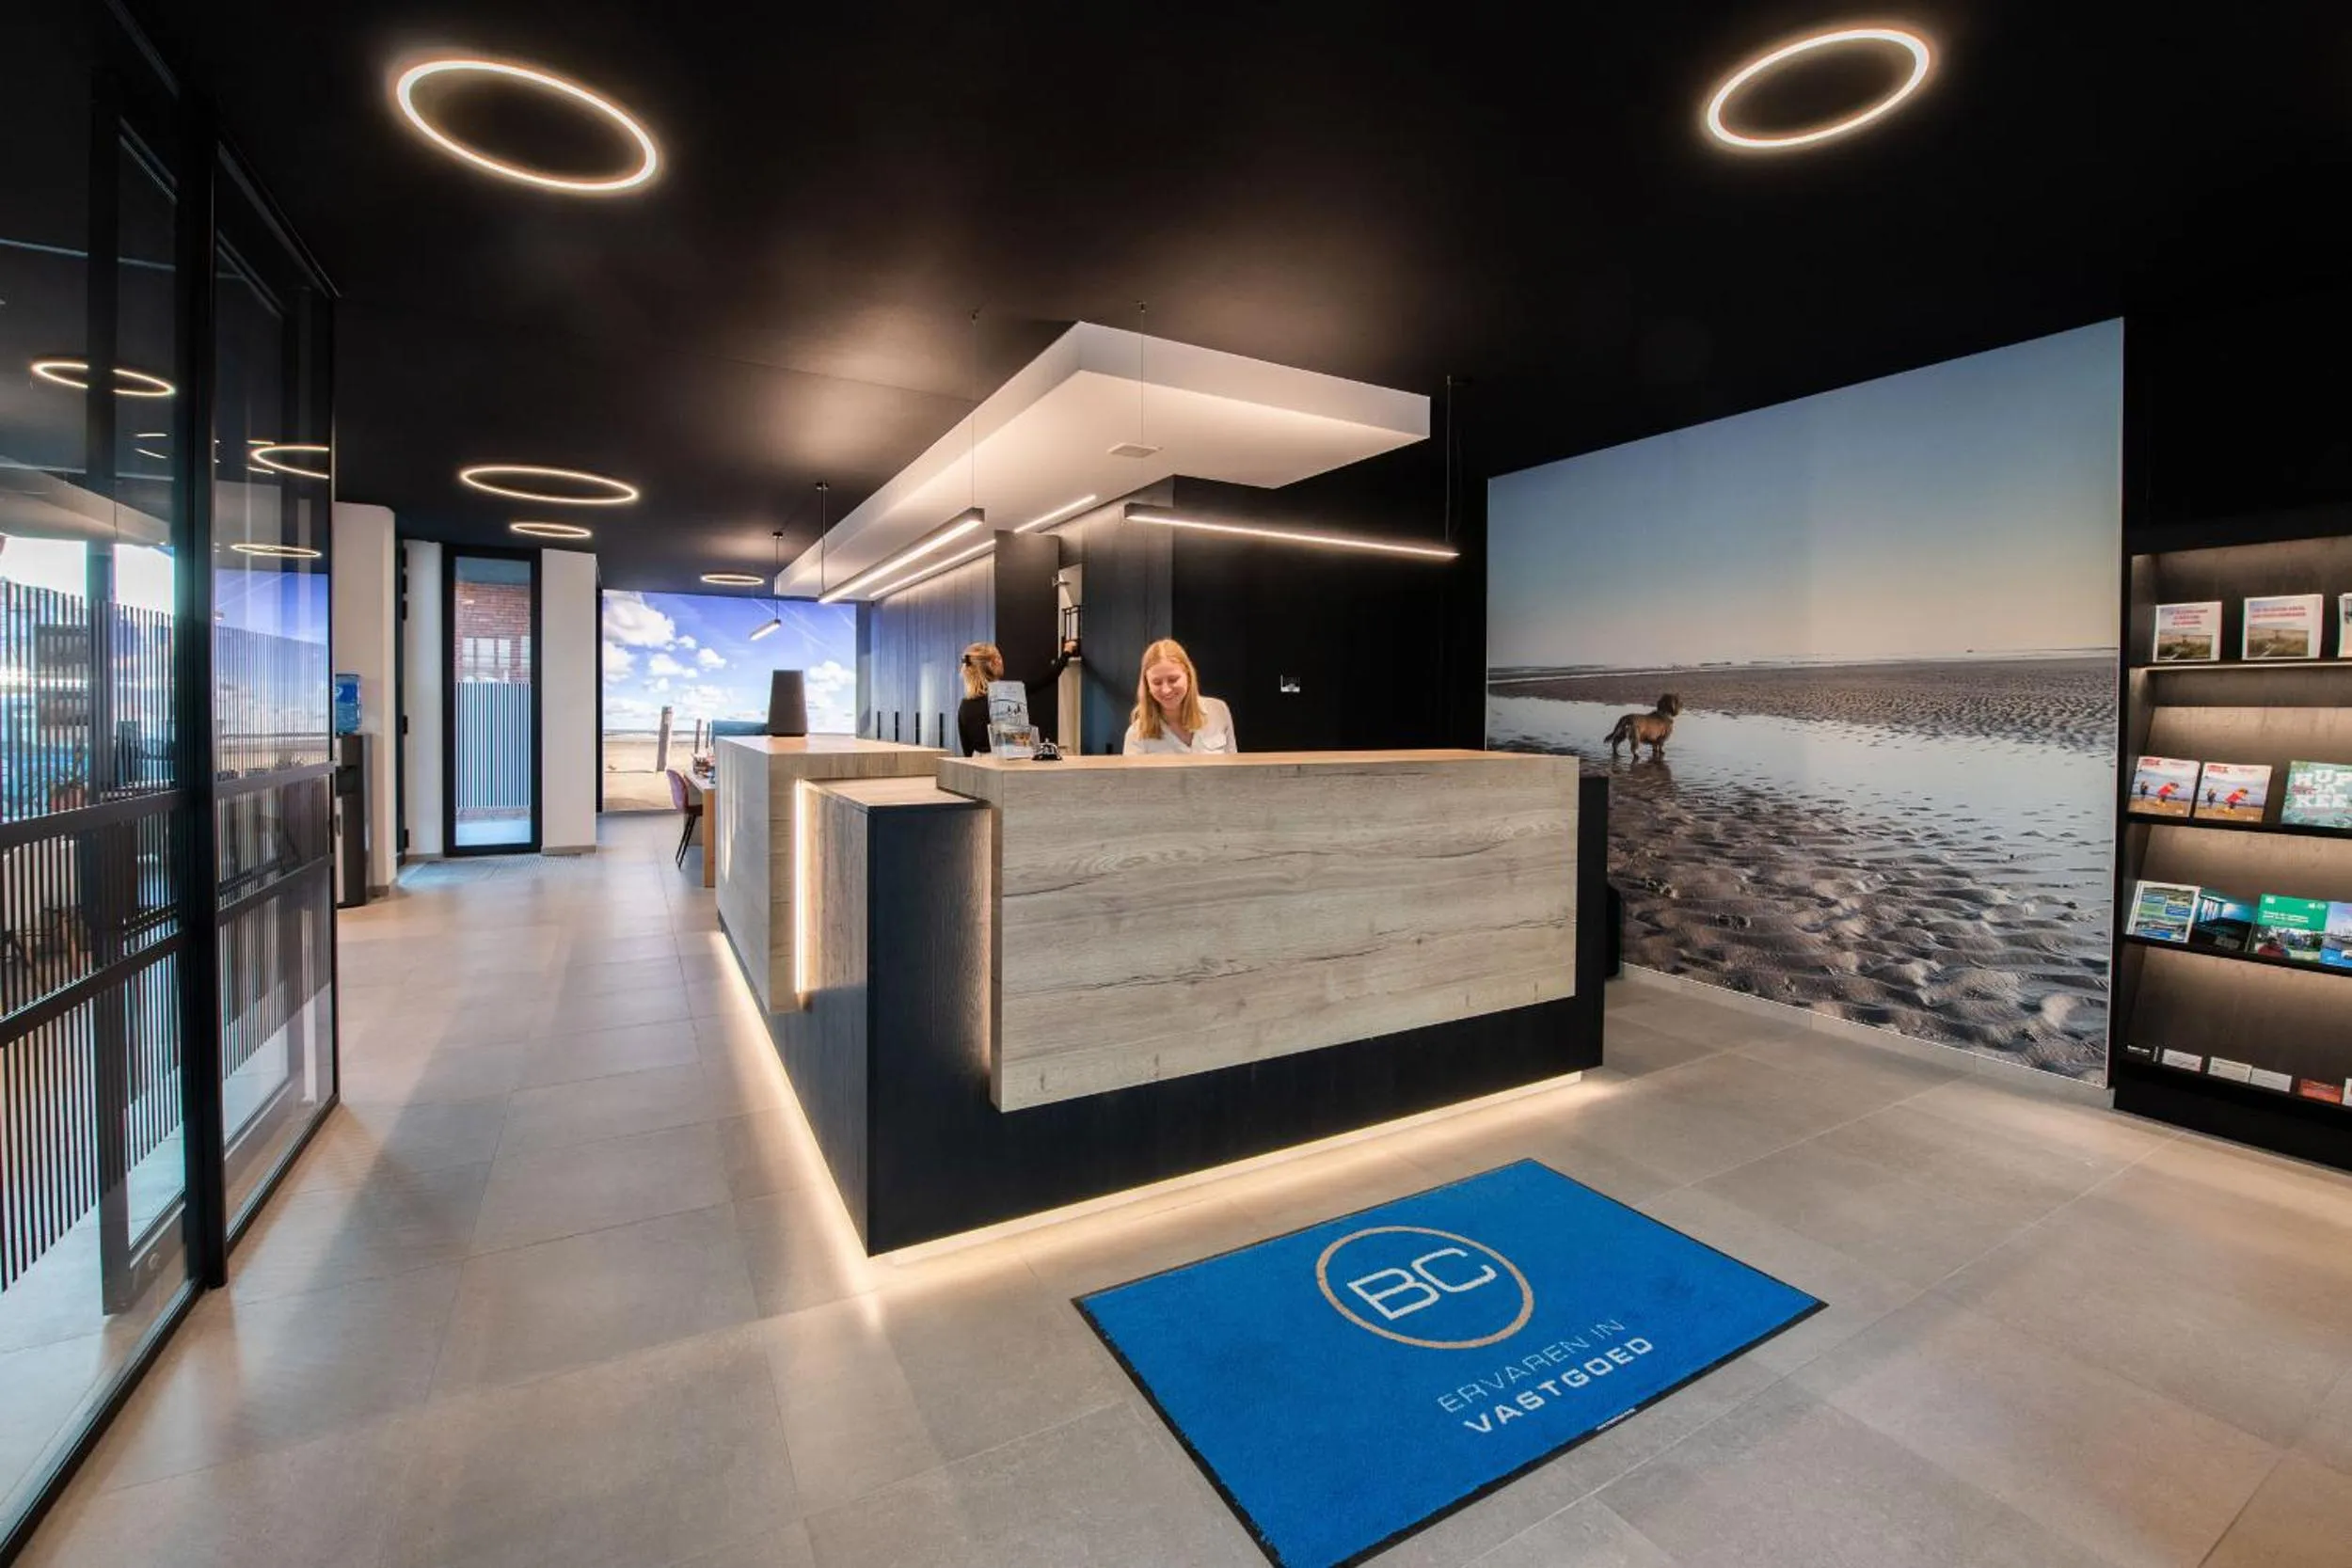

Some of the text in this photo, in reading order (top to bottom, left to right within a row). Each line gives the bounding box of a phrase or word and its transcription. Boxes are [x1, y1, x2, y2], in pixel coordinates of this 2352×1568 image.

[1347, 1247, 1498, 1321] BC
[1437, 1319, 1626, 1413] ERVAREN IN
[1463, 1337, 1653, 1433] VASTGOED
